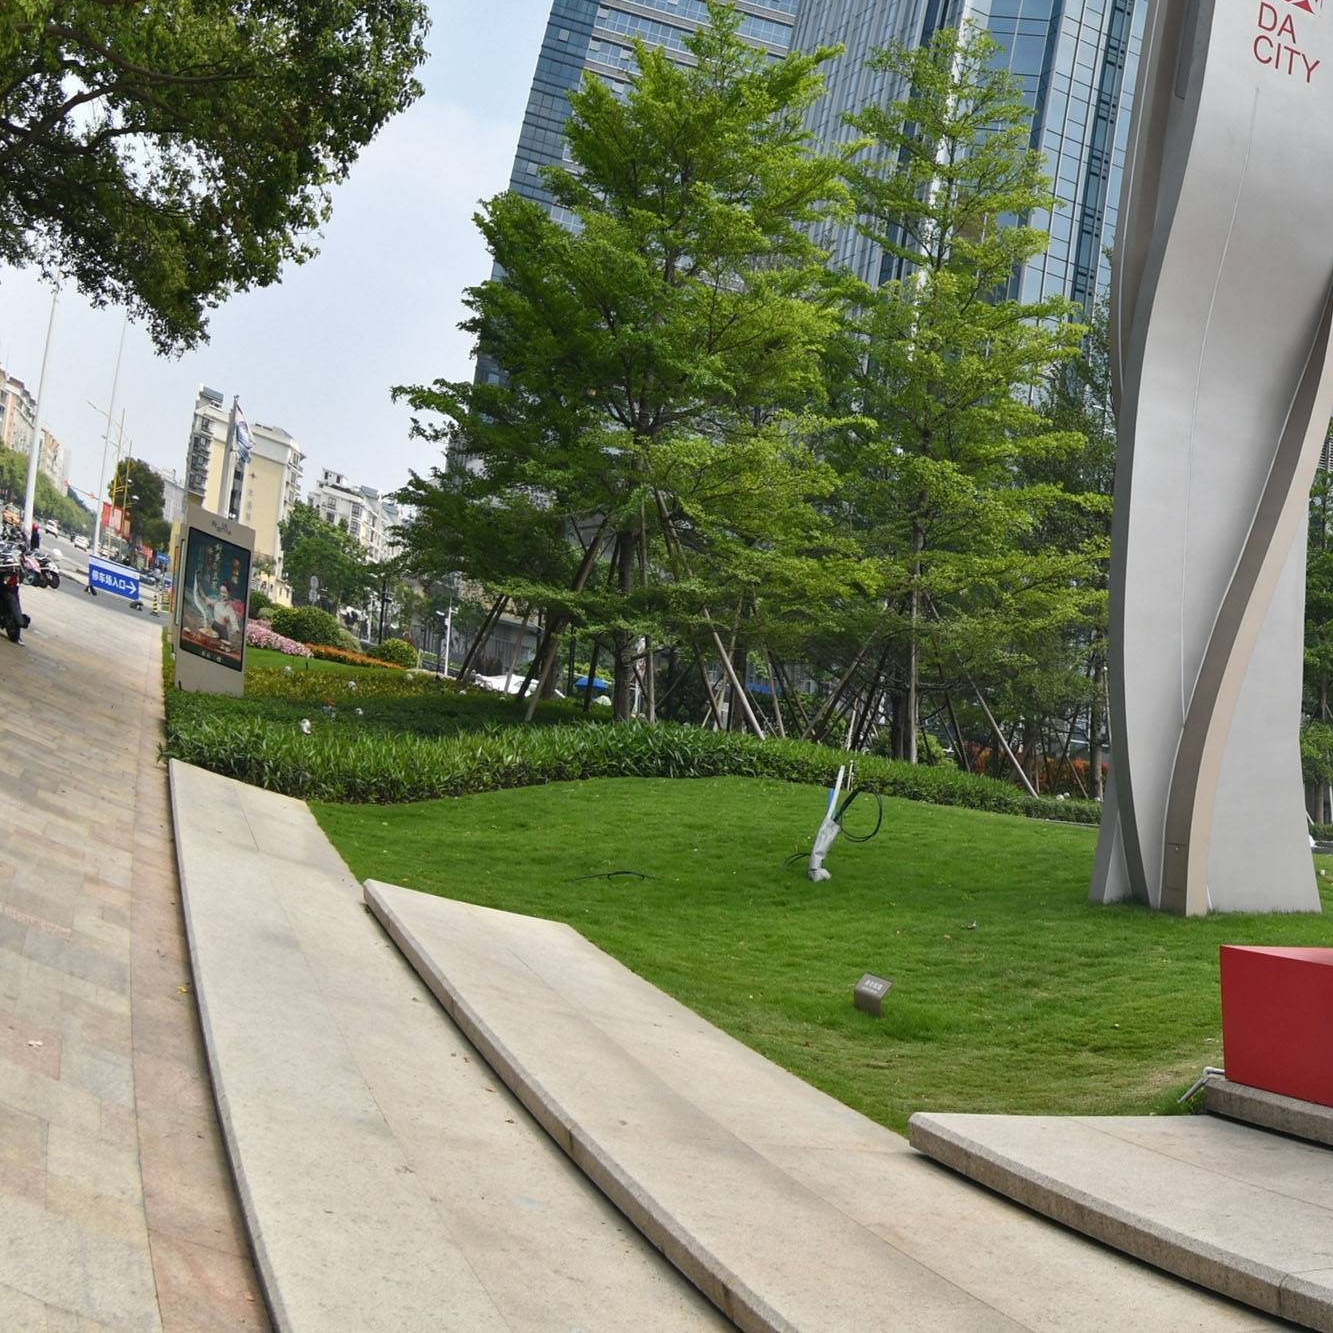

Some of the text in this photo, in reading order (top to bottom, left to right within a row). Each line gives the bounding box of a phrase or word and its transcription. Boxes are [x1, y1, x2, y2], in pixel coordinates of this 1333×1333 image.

[1257, 1, 1298, 44] DA
[1252, 35, 1320, 83] CITY
[91, 569, 126, 589] 停车场入口
